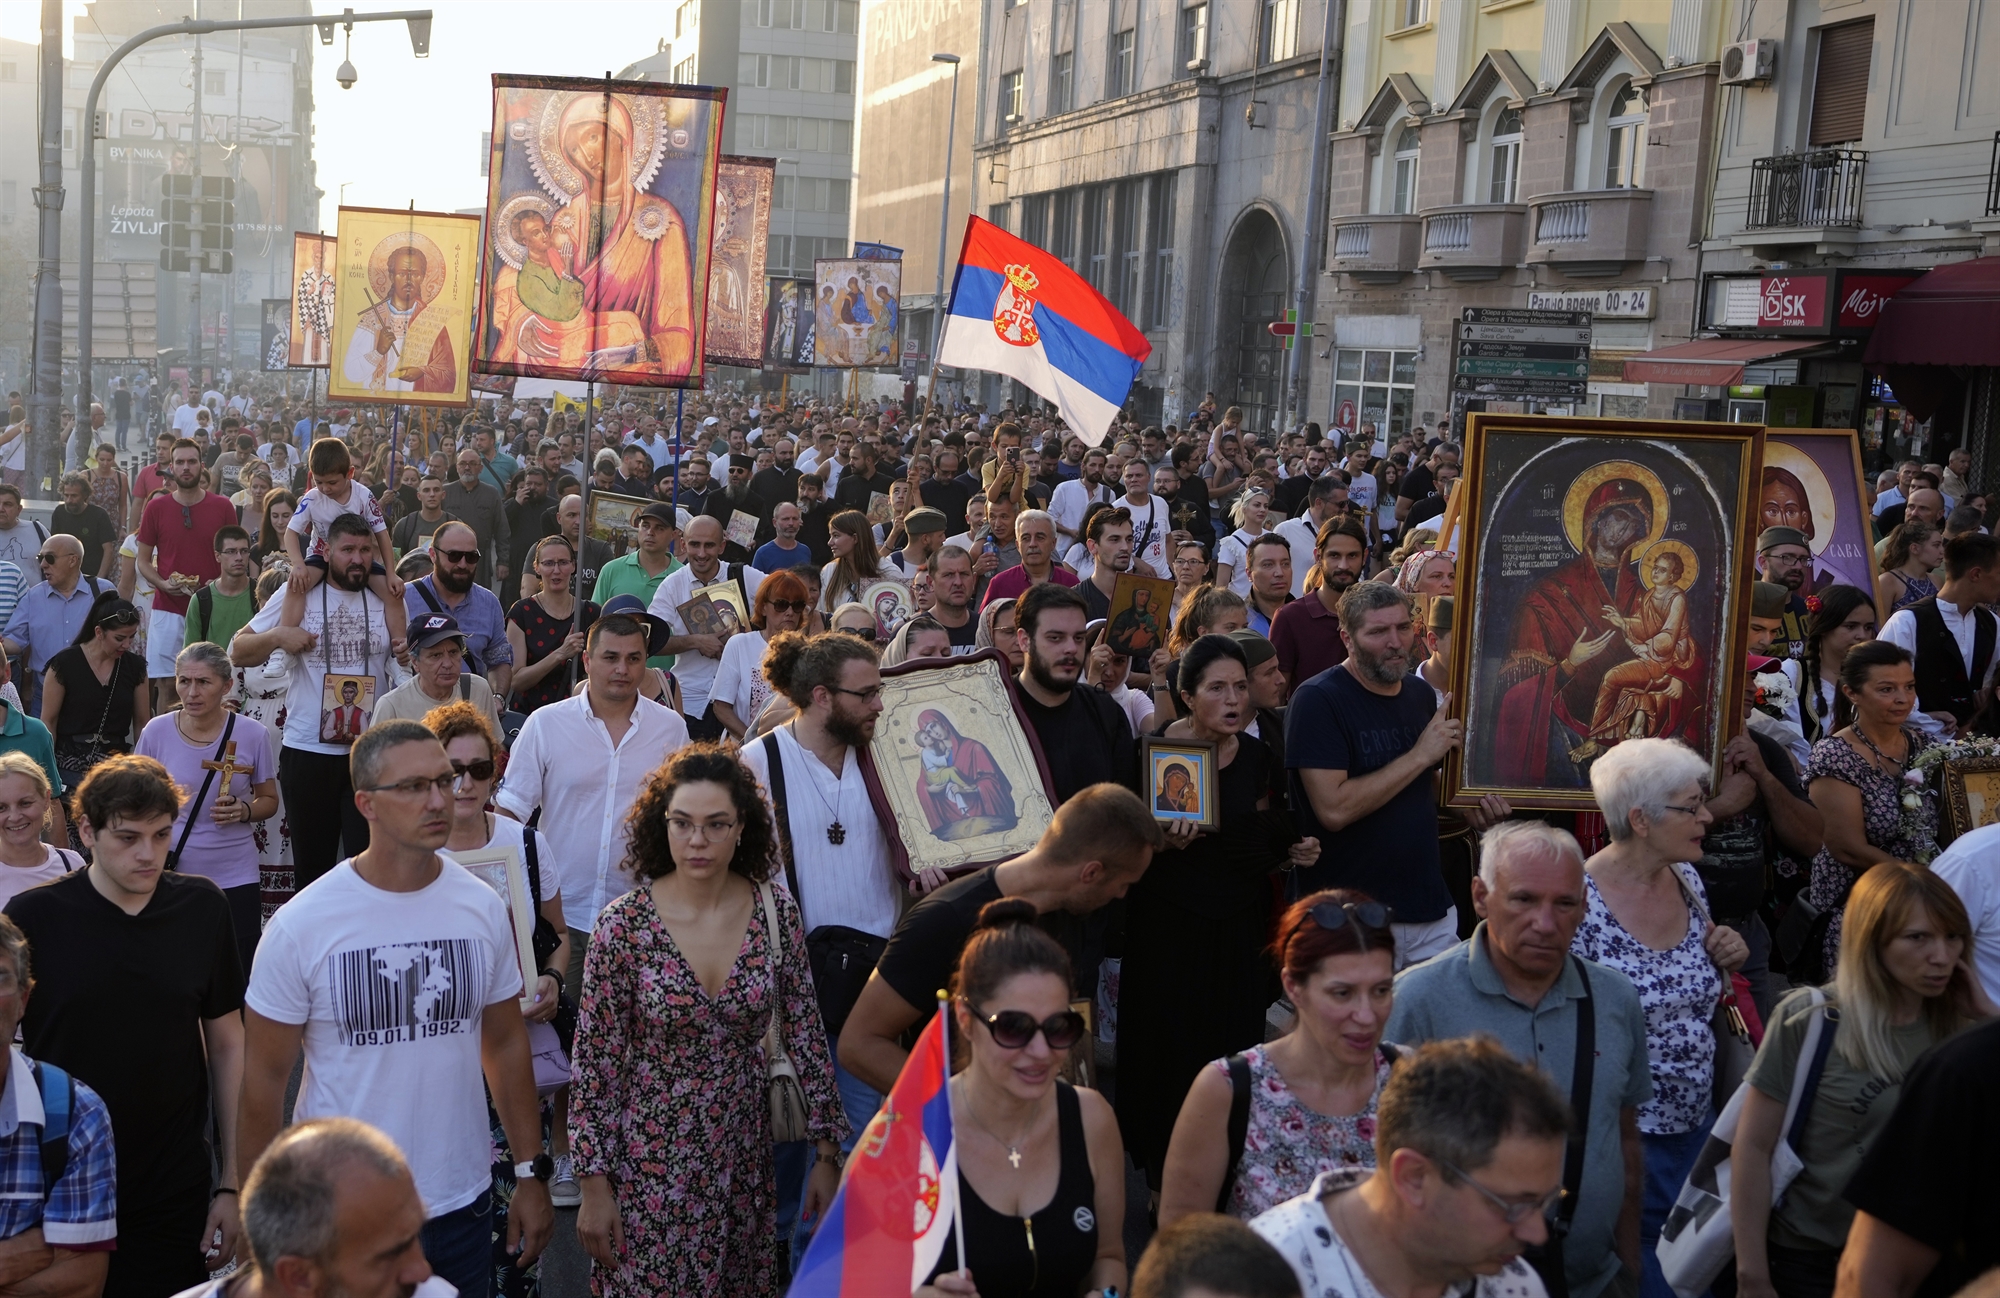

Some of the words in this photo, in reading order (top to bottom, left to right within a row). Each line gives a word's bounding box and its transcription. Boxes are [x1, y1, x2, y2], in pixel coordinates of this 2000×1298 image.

[111, 205, 154, 218] Lepota
[1605, 292, 1620, 311] 00
[1630, 291, 1645, 311] 24
[1840, 288, 1877, 318] Moj
[1506, 316, 1529, 324] Theatre
[1478, 349, 1500, 357] Gardos
[1507, 344, 1527, 352] Земун
[1830, 543, 1862, 558] САВА
[355, 1028, 407, 1046] 09.01.
[421, 1020, 465, 1038] 1992.
